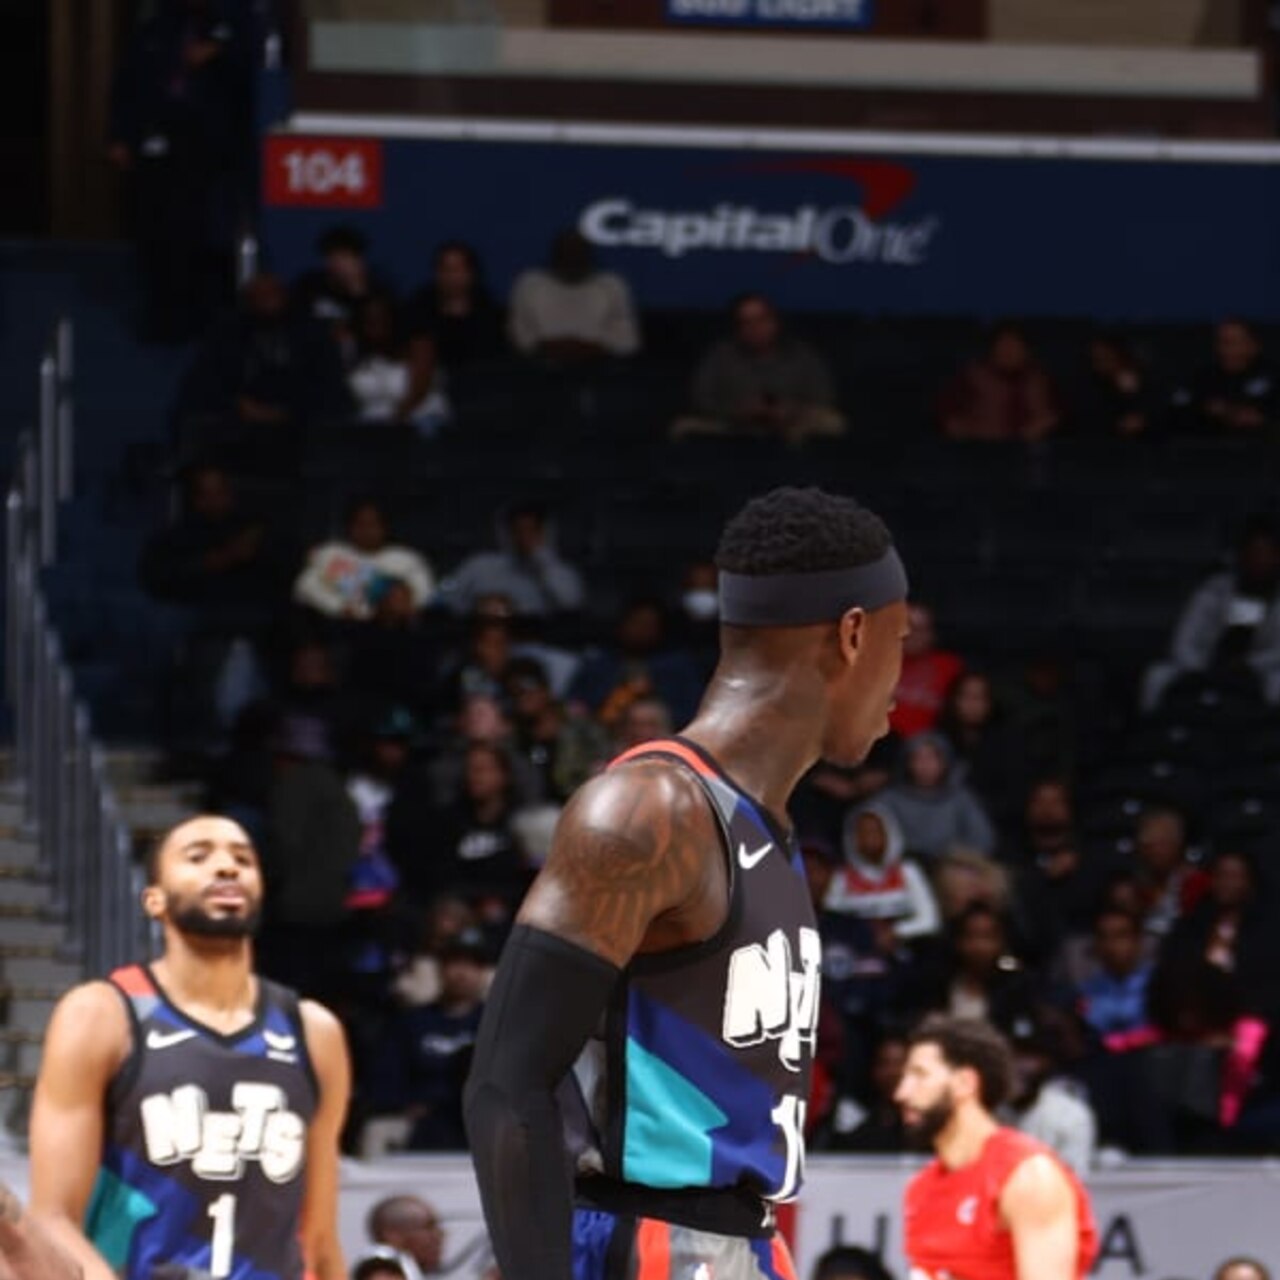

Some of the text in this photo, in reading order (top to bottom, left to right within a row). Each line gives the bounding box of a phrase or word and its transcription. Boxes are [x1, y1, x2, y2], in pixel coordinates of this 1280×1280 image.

[280, 150, 367, 194] 104
[140, 1081, 307, 1185] NETS
[208, 1193, 236, 1279] 1
